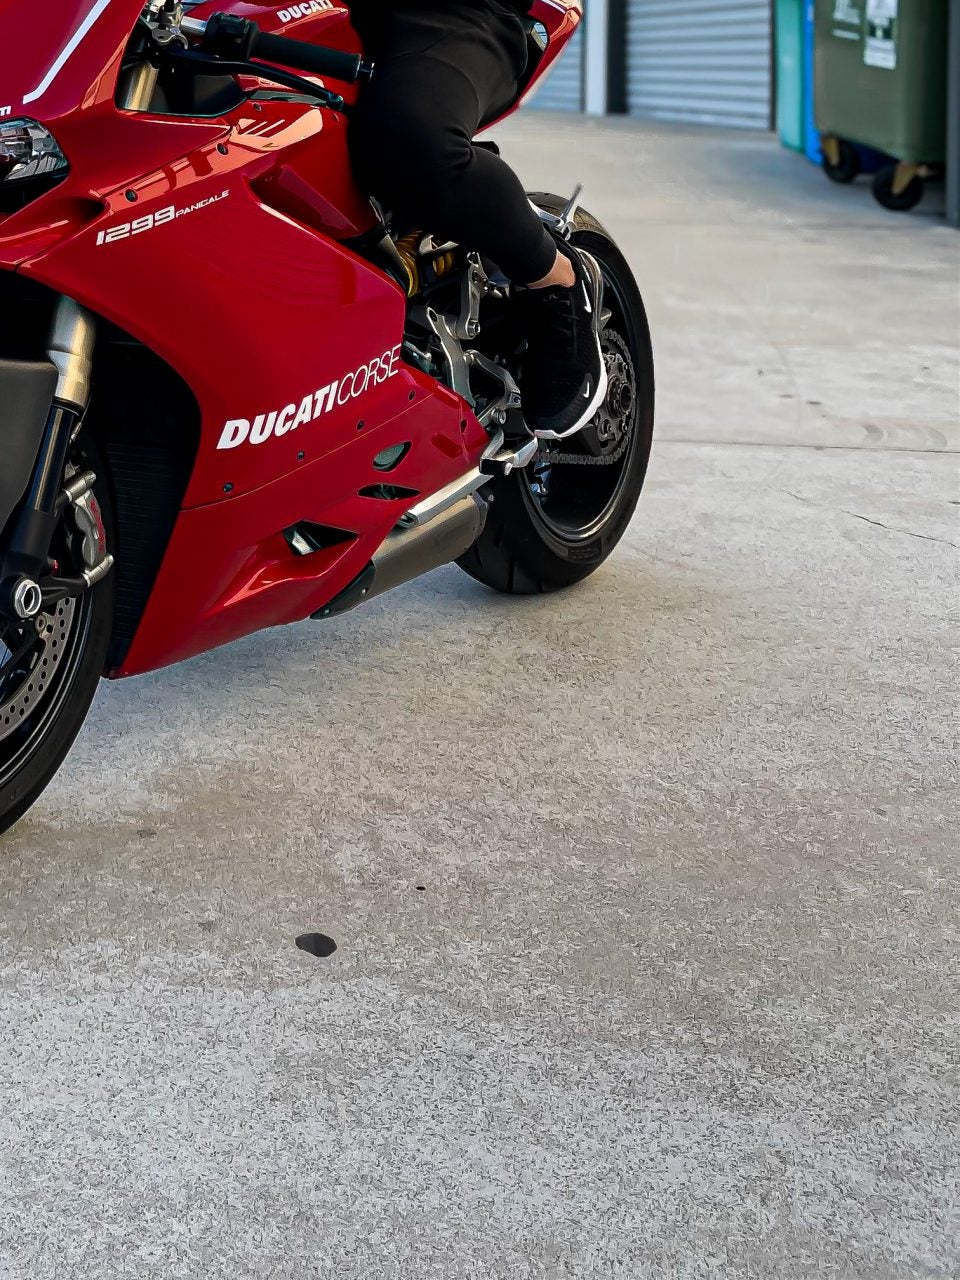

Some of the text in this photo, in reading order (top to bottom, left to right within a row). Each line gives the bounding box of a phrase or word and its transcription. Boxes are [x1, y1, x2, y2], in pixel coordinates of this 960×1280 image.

[96, 205, 176, 246] 1299
[216, 343, 402, 450] DUCATI CORSE
